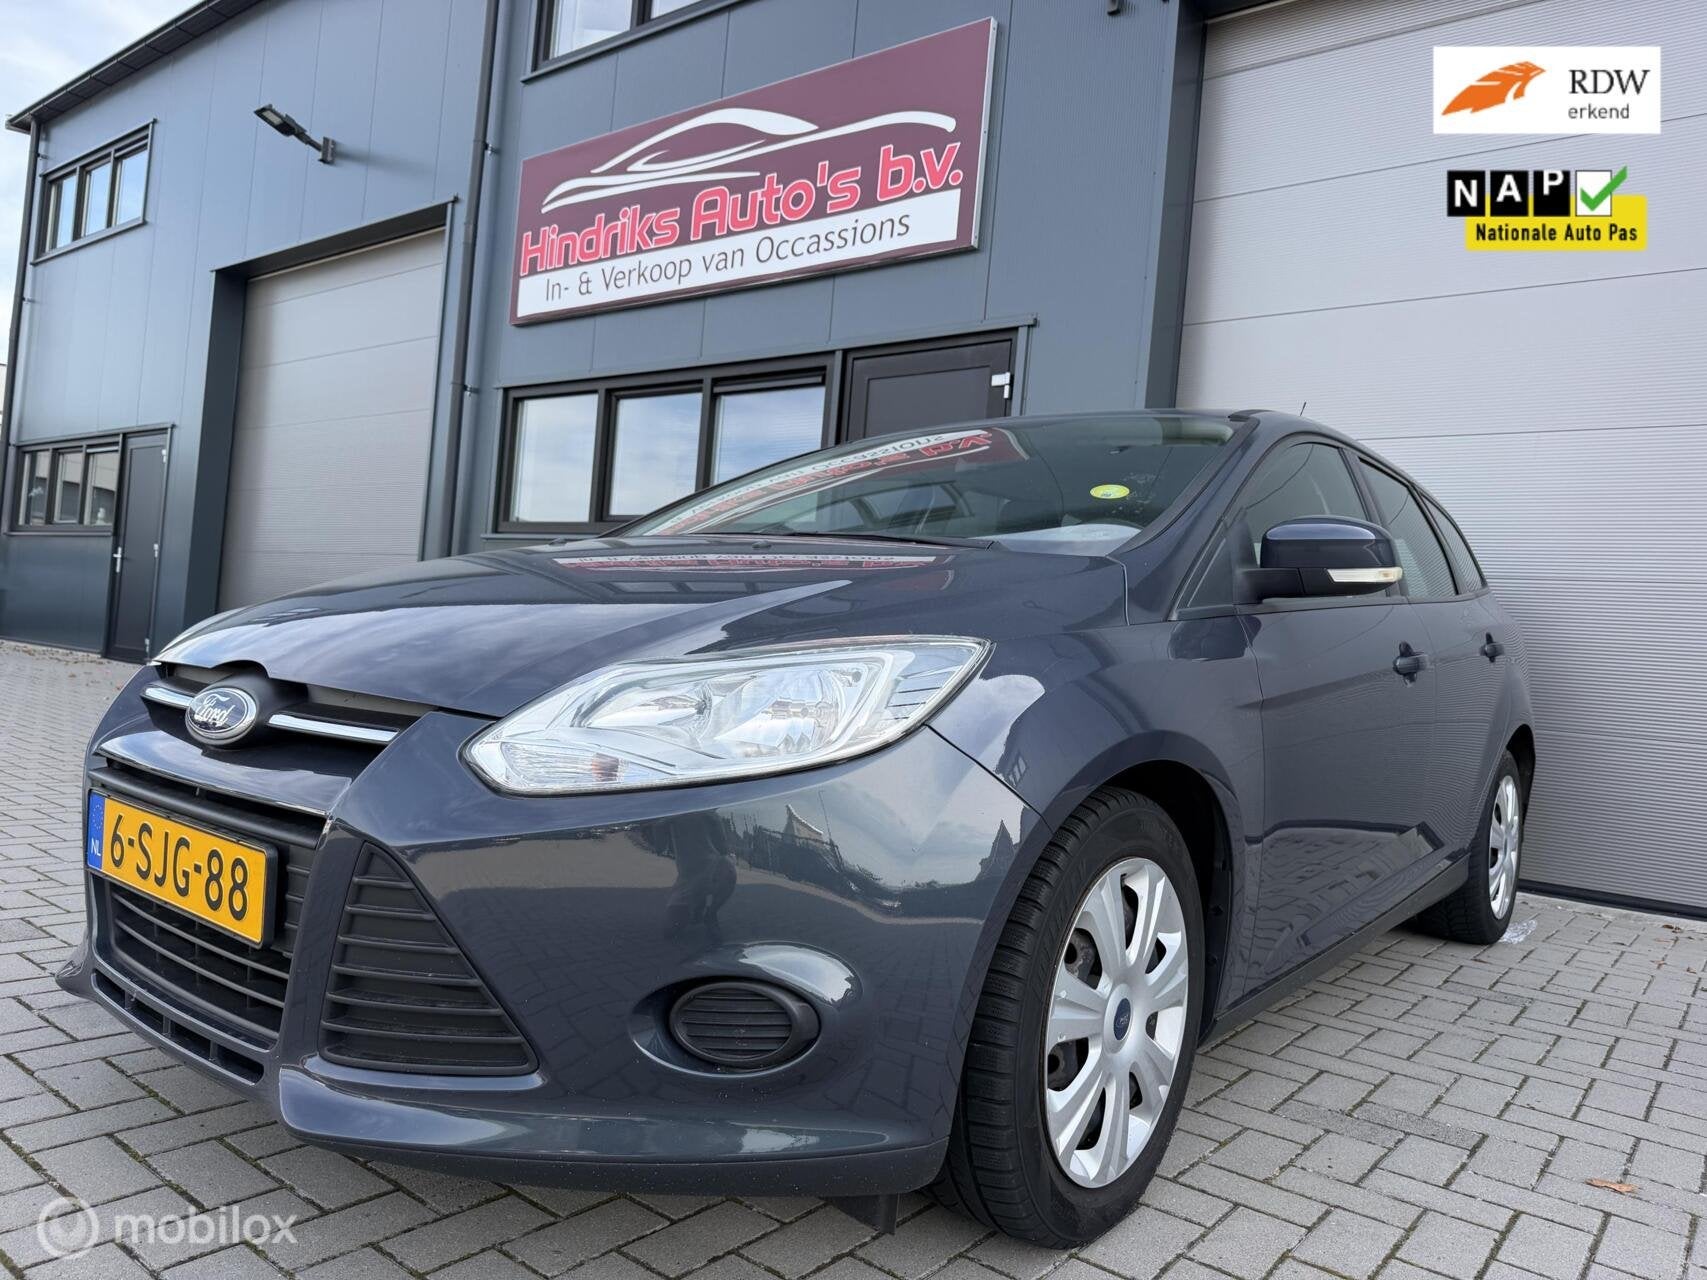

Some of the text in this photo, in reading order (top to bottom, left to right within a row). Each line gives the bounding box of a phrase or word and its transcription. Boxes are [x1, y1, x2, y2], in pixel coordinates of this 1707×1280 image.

[519, 142, 964, 277] Hindriks Auto's b.v.
[545, 213, 911, 302] In- & Verkoop van Occassions
[194, 694, 235, 727] Ford
[91, 837, 102, 857] NL
[110, 813, 249, 922] 6-SJG-88
